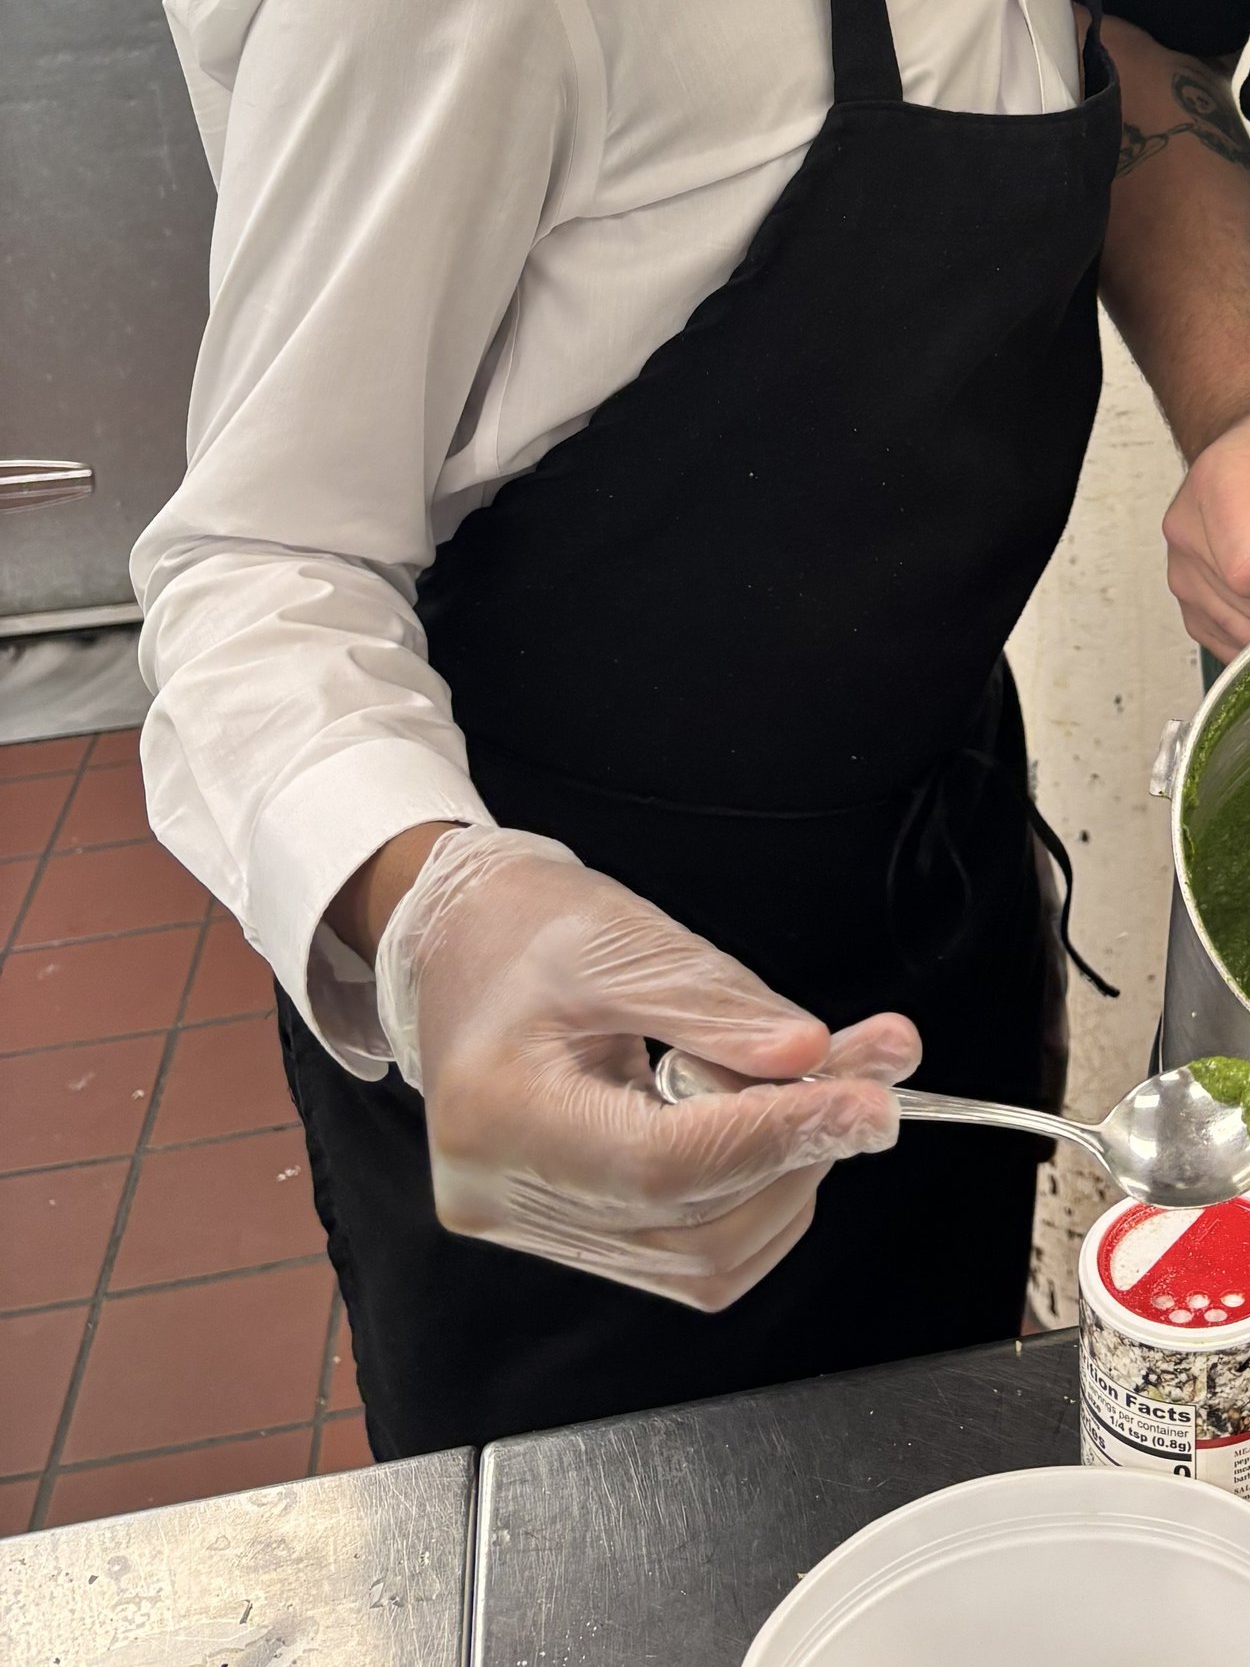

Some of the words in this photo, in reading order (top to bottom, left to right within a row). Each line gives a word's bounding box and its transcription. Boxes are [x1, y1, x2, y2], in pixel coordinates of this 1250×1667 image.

[1126, 1393, 1191, 1423] Facts
[1109, 1415, 1126, 1432] 1/4
[1128, 1427, 1148, 1443] tsp
[1152, 1436, 1192, 1453] (0.8g)
[1119, 1411, 1135, 1425] per
[1137, 1419, 1190, 1439] container
